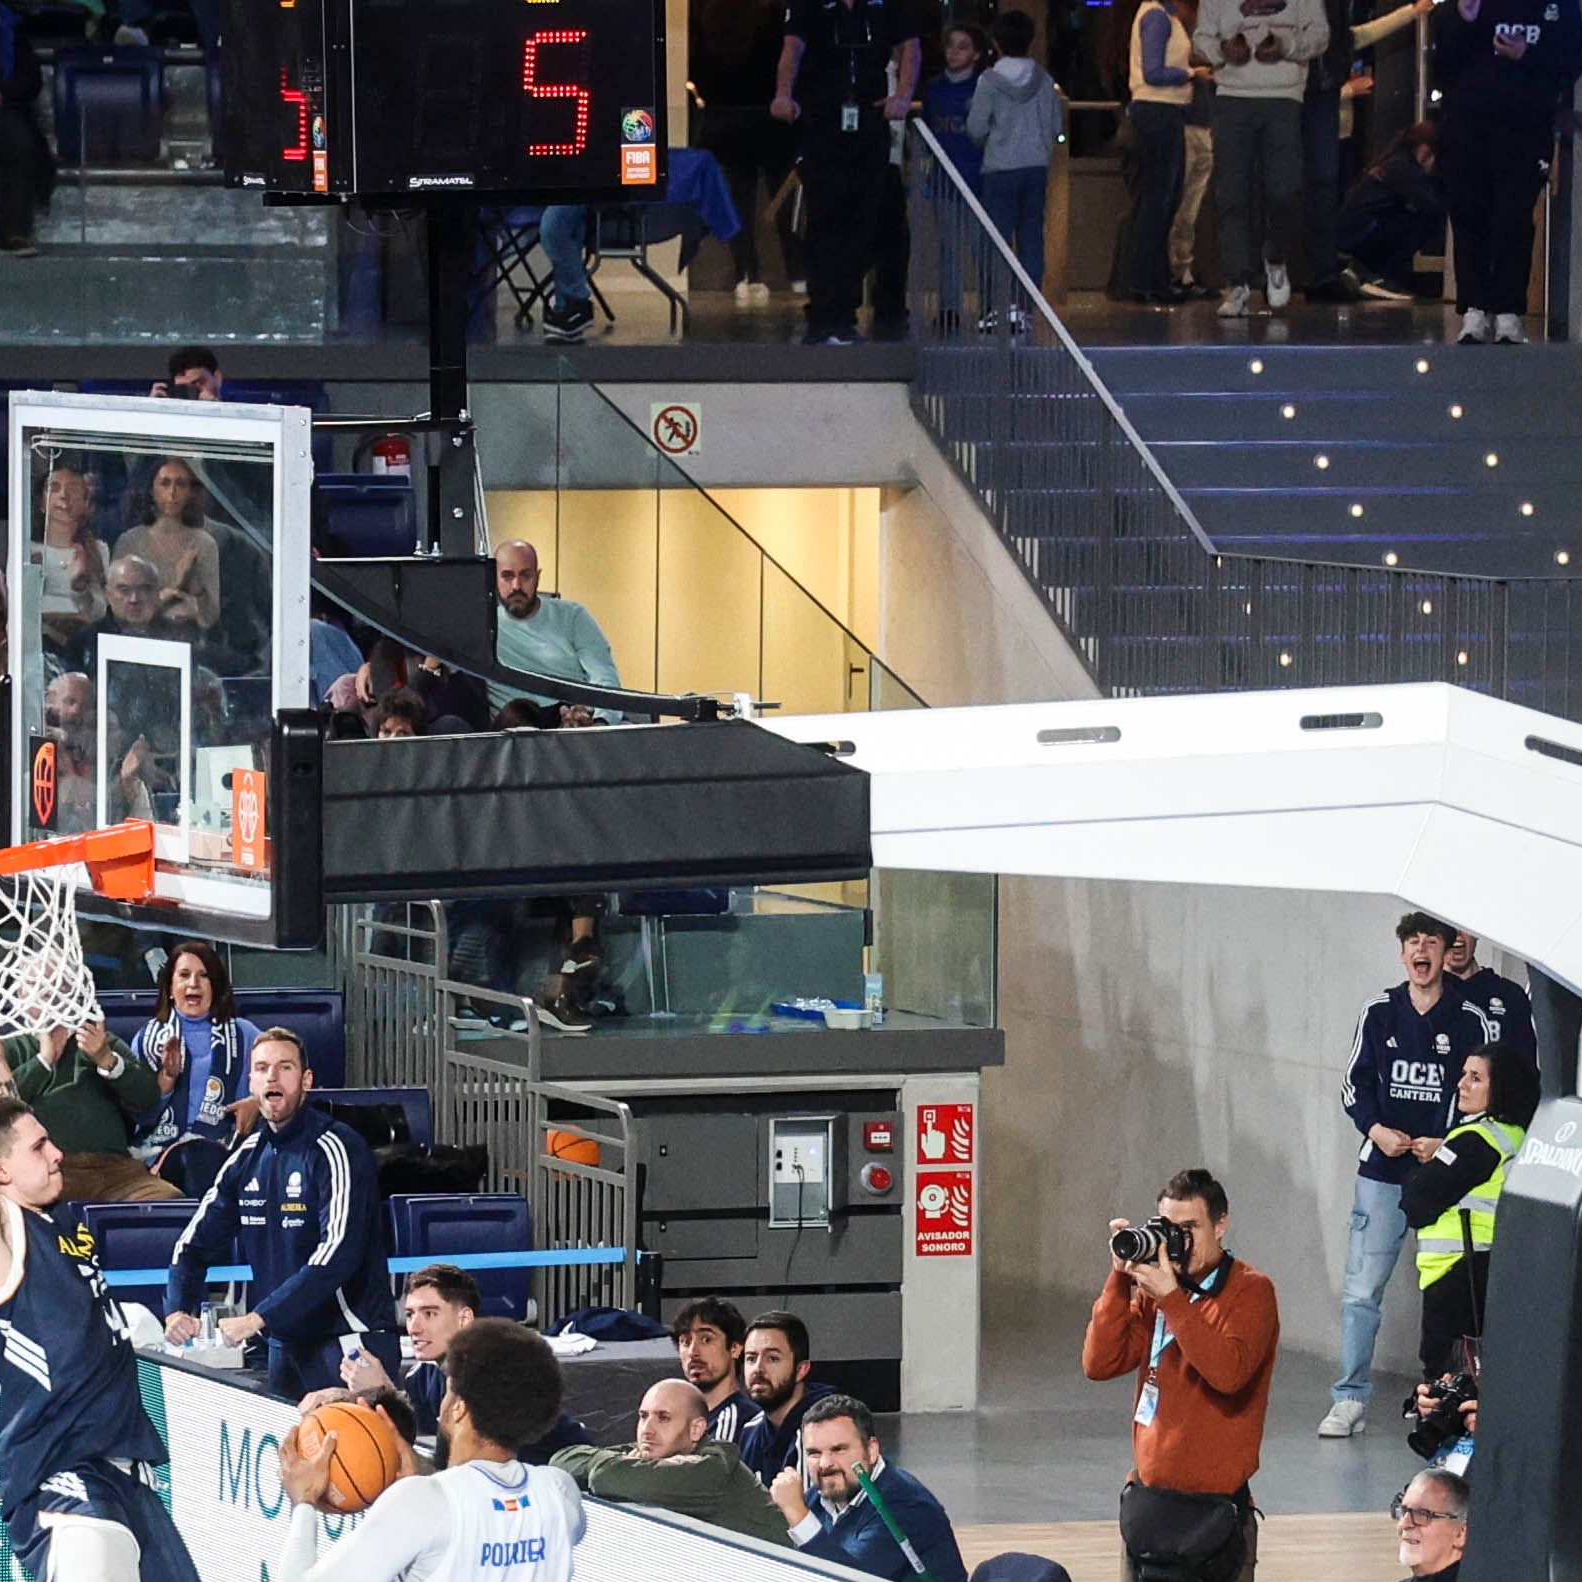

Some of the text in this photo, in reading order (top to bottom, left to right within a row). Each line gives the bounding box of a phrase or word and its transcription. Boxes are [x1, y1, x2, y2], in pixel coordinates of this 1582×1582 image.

[524, 30, 588, 156] 5
[626, 150, 650, 164] FIBA
[409, 177, 473, 188] STRAMATEL
[1389, 1087, 1441, 1103] CANTERA
[918, 1230, 969, 1241] AVISADOR
[922, 1243, 965, 1252] SONORO
